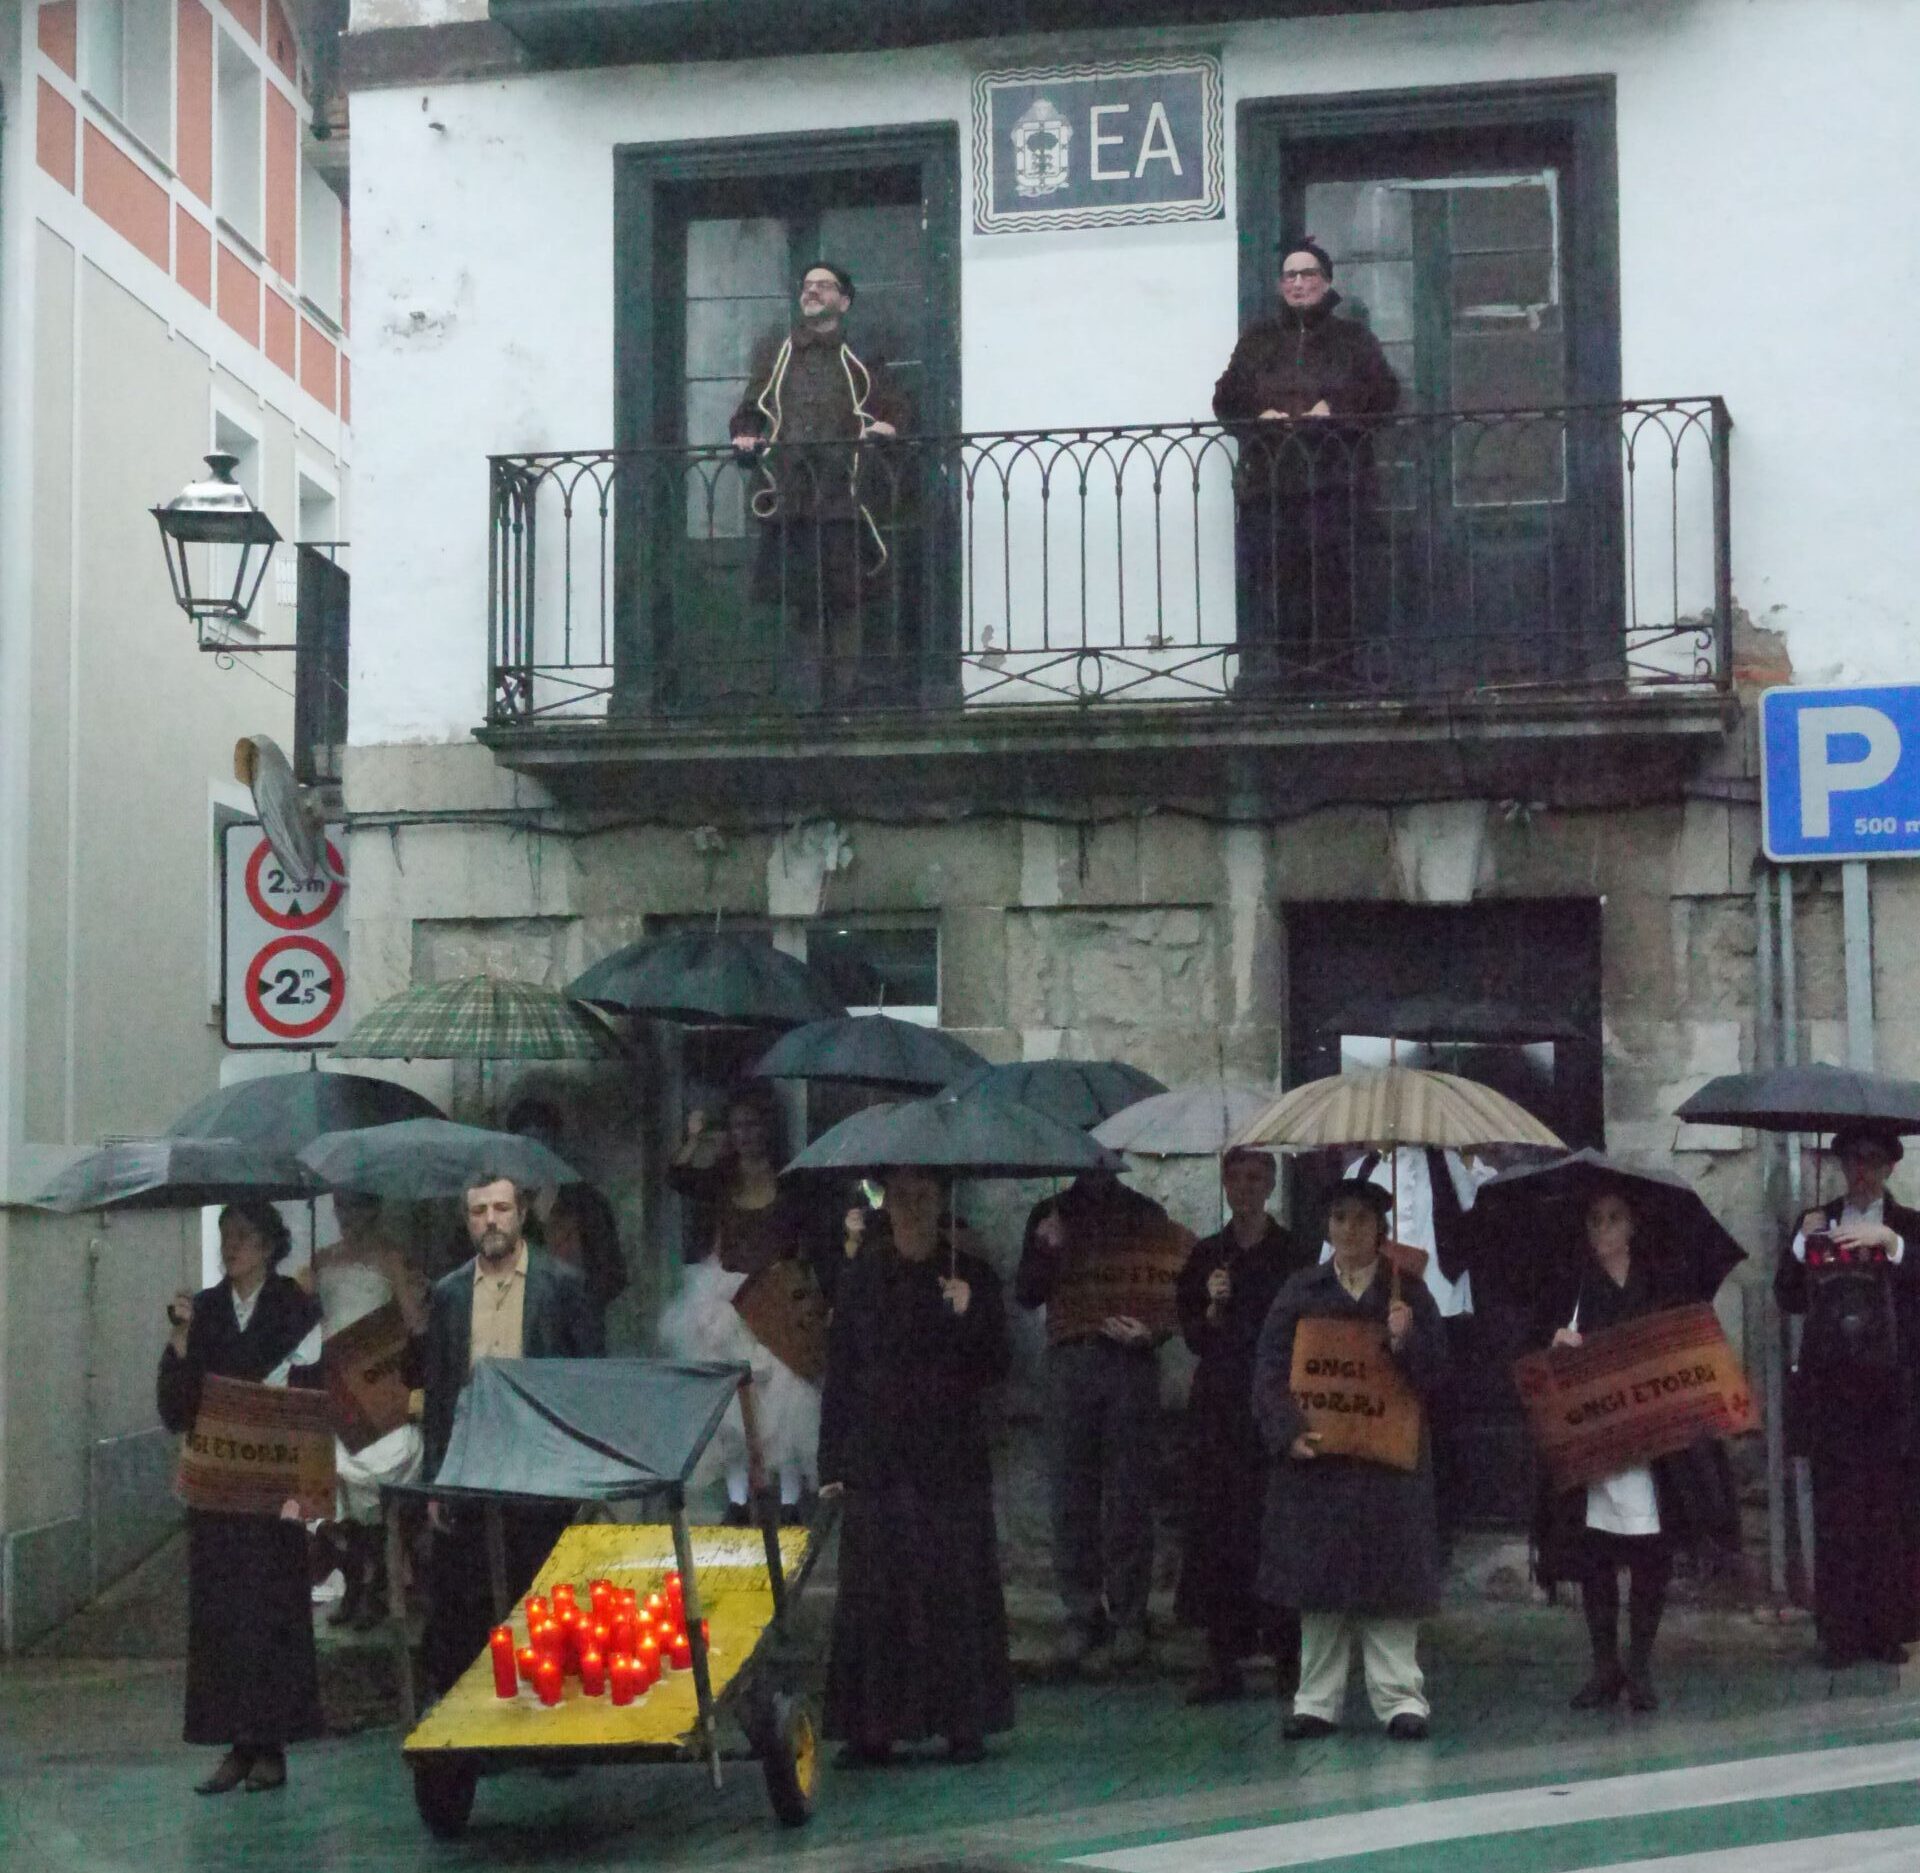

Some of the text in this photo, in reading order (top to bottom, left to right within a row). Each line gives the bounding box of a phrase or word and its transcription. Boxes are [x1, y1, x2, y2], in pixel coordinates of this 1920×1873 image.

[1090, 101, 1183, 180] EA
[1798, 705, 1901, 838] P
[1854, 817, 1920, 834] 500 m
[1305, 1358, 1367, 1380] ONGI
[1296, 1391, 1386, 1419] TORRI
[1565, 1390, 1626, 1426] ONGI
